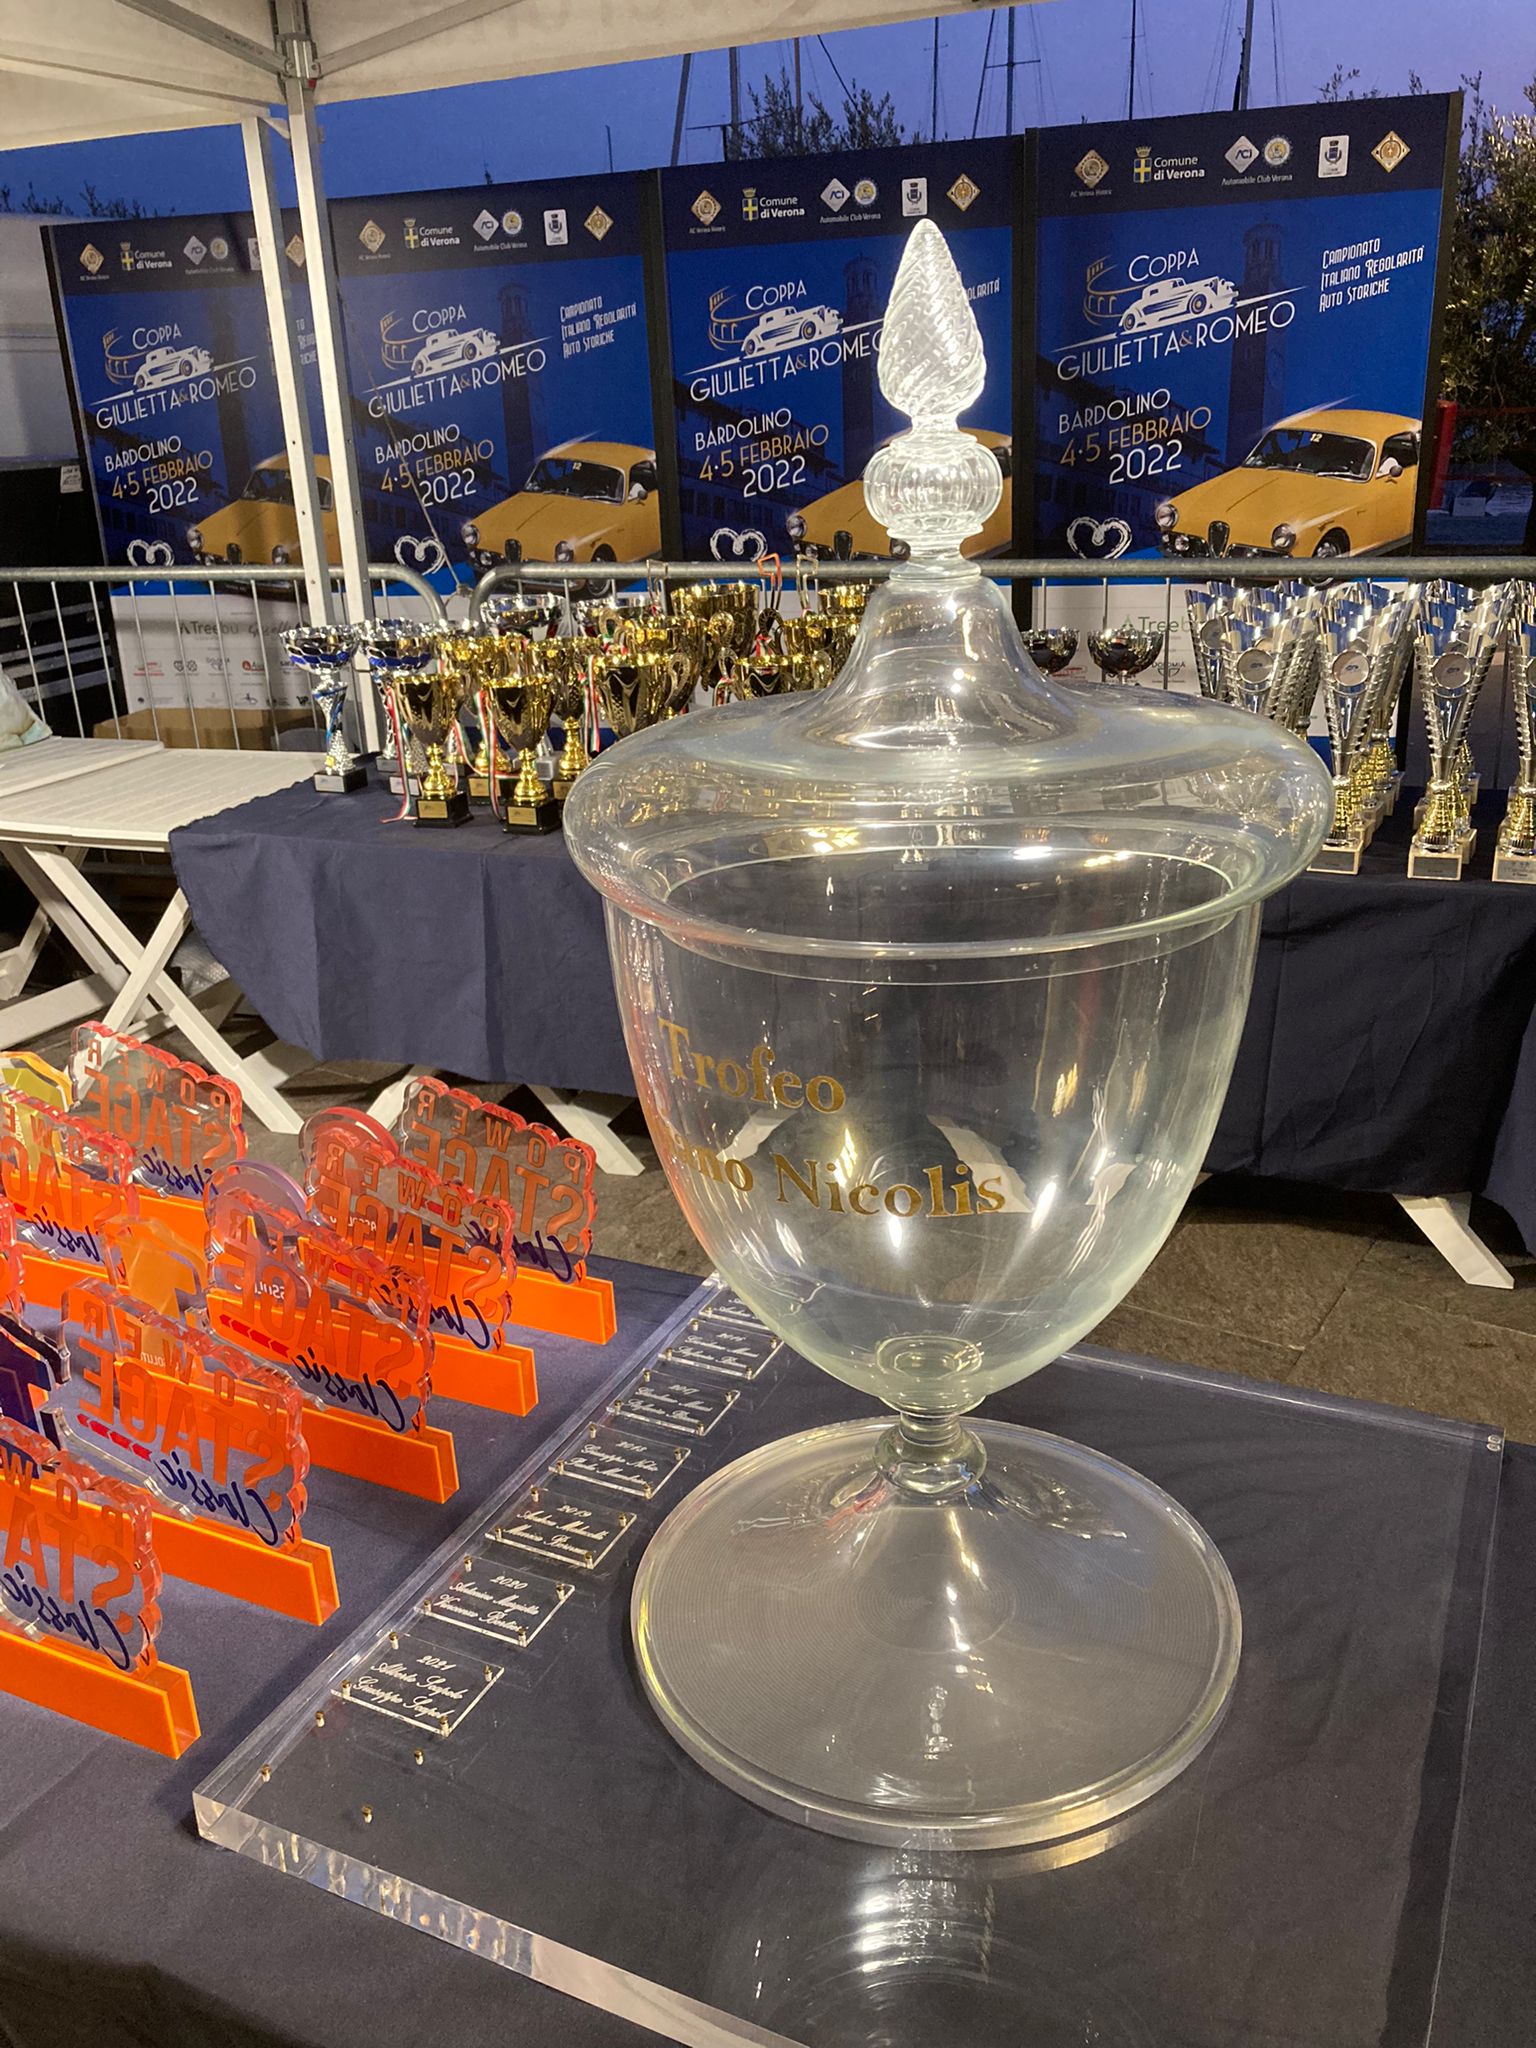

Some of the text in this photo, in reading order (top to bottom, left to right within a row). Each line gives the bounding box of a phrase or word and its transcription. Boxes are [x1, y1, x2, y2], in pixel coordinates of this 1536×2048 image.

[1154, 157, 1198, 168] Comune
[1154, 168, 1205, 180] di Verona
[759, 198, 798, 207] Comune
[760, 207, 805, 219] di Verona
[419, 227, 453, 236] Comune
[421, 236, 460, 247] di Verona
[145, 259, 173, 269] Verona
[1129, 248, 1199, 283] COPPA
[746, 280, 806, 309] COPPA
[132, 322, 182, 350] COPPA
[413, 304, 467, 333] COPPA
[1059, 388, 1171, 434] BARDOLINO
[376, 423, 460, 465] BARDOLINO
[695, 408, 792, 451] BARDOLINO
[740, 424, 829, 467] FEBBRAIO
[1108, 406, 1211, 453] FEBBRAIO
[105, 435, 182, 473] BARDOLINO
[143, 450, 213, 486] FEBBRAIO
[416, 439, 494, 479] FEBBRAIO
[1109, 440, 1182, 484] 2022
[420, 468, 477, 508] 2022
[743, 455, 806, 498] 2022
[147, 477, 199, 514] 2022
[657, 1017, 846, 1114] Trofeo
[772, 1153, 1006, 1219] Nicolis
[557, 1505, 592, 1517] 2019
[490, 1575, 528, 1590] 2020
[416, 1655, 456, 1671] 2021
